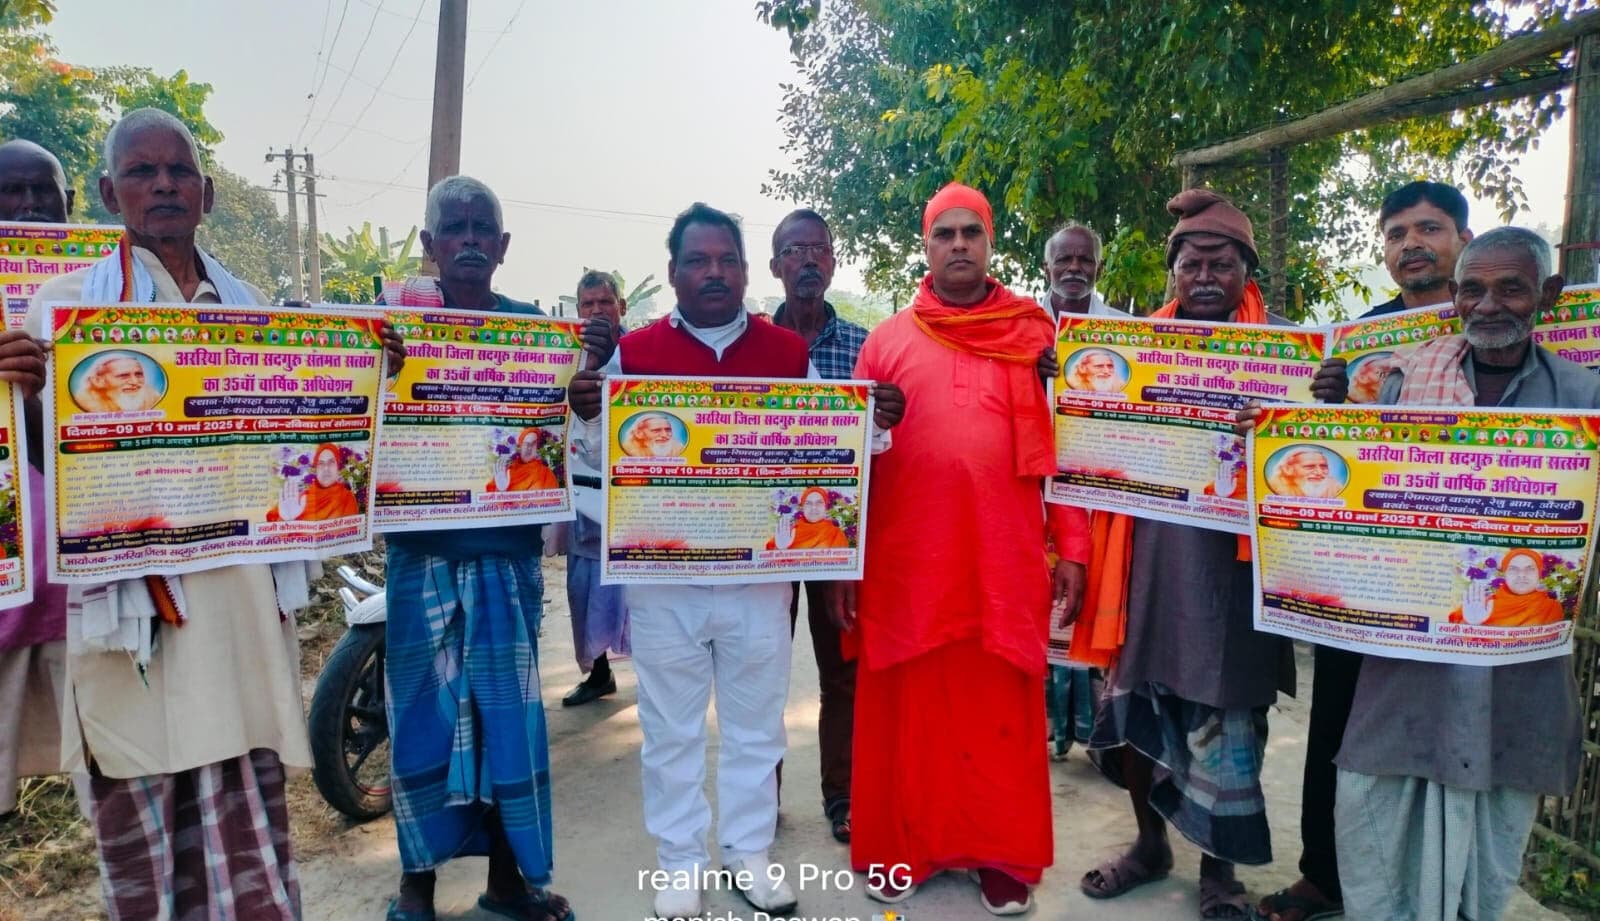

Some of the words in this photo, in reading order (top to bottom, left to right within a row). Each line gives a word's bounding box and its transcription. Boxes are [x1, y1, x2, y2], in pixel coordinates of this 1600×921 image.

[27, 259, 59, 273] जिला
[6, 284, 22, 295] का
[1548, 325, 1587, 342] संतमत
[176, 348, 221, 366] अररिया
[226, 349, 258, 366] जिला
[264, 352, 301, 370] सदगुरु
[307, 350, 340, 367] संतमत
[345, 351, 375, 368] सत्संग
[407, 343, 442, 359] अररिया
[446, 345, 474, 360] जिला
[478, 348, 510, 365] सदगुरु
[514, 348, 544, 363] संतमत
[549, 350, 573, 364] सत्संग
[1136, 349, 1172, 364] अररिया
[1176, 352, 1202, 368] जिला
[1207, 357, 1239, 374] सदगुरु
[1243, 358, 1276, 374] संतमत
[1281, 362, 1313, 377] सत्संग
[204, 377, 218, 392] का
[259, 375, 298, 392] वार्षिक
[303, 375, 353, 392] अधिवेशन
[427, 369, 439, 380] का
[473, 368, 505, 382] वार्षिक
[508, 369, 555, 384] अधिवेशन
[1157, 372, 1170, 384] का
[1203, 375, 1235, 390] वार्षिक
[1238, 379, 1288, 396] अधिवेशन
[406, 403, 424, 411] मार्च
[427, 404, 451, 412] 2025
[1121, 402, 1133, 410] 10
[1155, 406, 1181, 414] 2025
[66, 425, 134, 437] दिनांक-09
[137, 422, 153, 433] एवं
[156, 422, 173, 432] 10
[177, 421, 200, 431] मार्च
[203, 420, 233, 430] 2025
[695, 411, 731, 425] अररिया
[734, 412, 760, 426] जिला
[765, 415, 796, 430] सदगुरु
[799, 412, 828, 426] संतमत
[832, 412, 859, 427] सत्संग
[716, 434, 728, 445] का
[761, 432, 791, 445] वार्षिक
[794, 432, 837, 445] अधिवेशन
[1358, 445, 1403, 462] अररिया
[1409, 446, 1443, 464] जिला
[1449, 451, 1493, 471] सदगुरु
[1498, 449, 1544, 469] संतमत
[1549, 452, 1590, 471] सत्संग
[1383, 473, 1400, 486] का
[1444, 473, 1486, 491] वार्षिक
[1491, 476, 1558, 496] अधिवेशन
[1367, 491, 1446, 503] स्थान-सिमराहा
[1449, 495, 1484, 506] बाजार,
[1539, 499, 1576, 510] औराही
[383, 508, 402, 517] जिला
[1483, 506, 1559, 519] जिला-अररिया
[1318, 509, 1335, 519] एवं
[1338, 511, 1353, 520] 10
[1356, 513, 1378, 522] मार्च
[1381, 514, 1413, 524] 2025
[1513, 523, 1533, 533] एवं
[1534, 524, 1583, 535] सोमवार)
[144, 546, 167, 560] जिला
[200, 541, 225, 552] संतमत
[1324, 622, 1343, 634] जिला
[1375, 632, 1403, 641] संतमत
[1435, 637, 1463, 647] समिति
[1438, 625, 1460, 633] स्वामी
